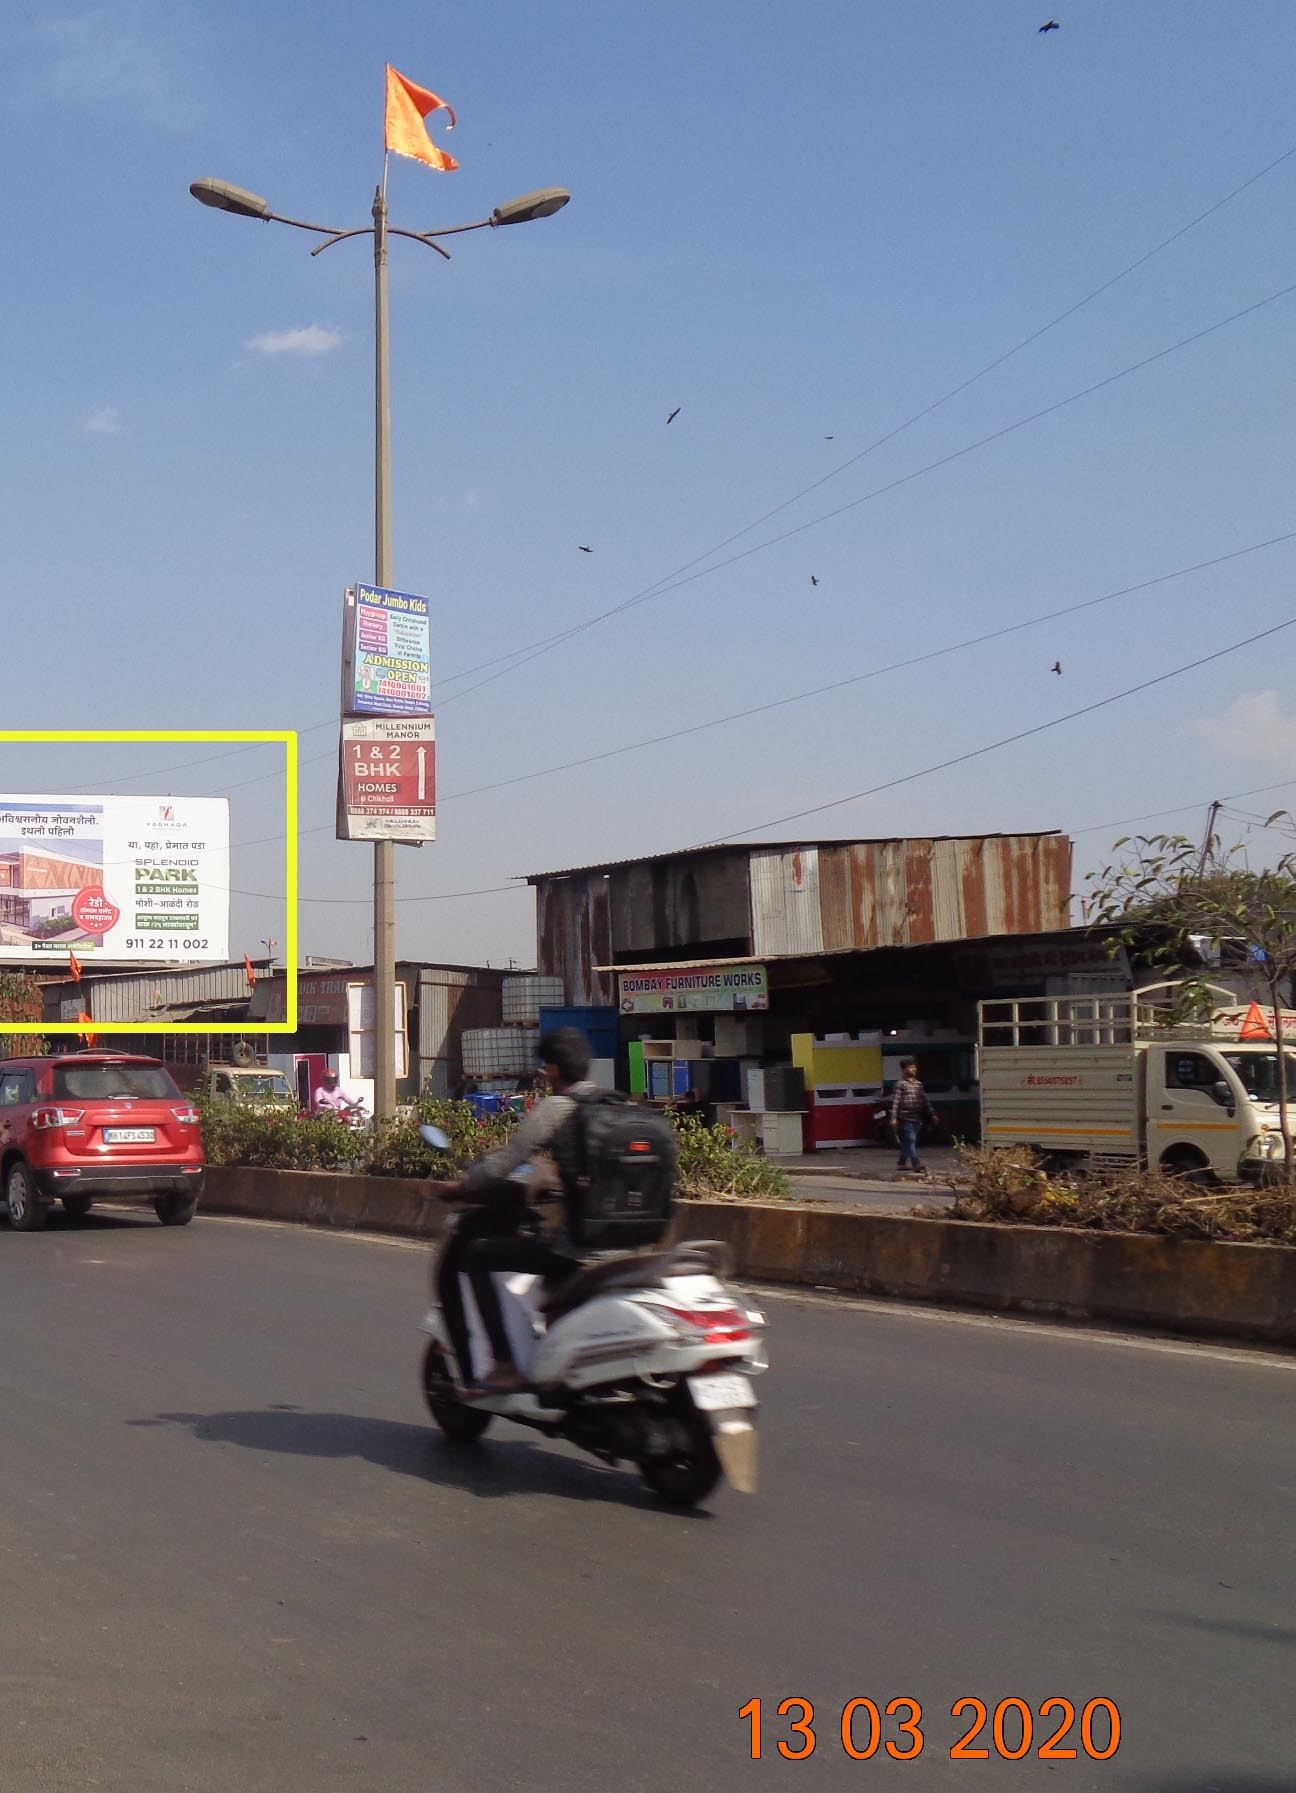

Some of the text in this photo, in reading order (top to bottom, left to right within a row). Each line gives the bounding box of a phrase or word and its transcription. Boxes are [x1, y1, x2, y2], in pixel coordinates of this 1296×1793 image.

[360, 588, 427, 613] Podar Jumbo Kids
[364, 653, 429, 672] ADMISSION
[387, 669, 417, 683] OPEN
[352, 744, 400, 758] 1 & 2
[354, 762, 401, 776] BHK
[358, 784, 397, 792] HOMES
[135, 858, 199, 866] SPLENDID
[135, 868, 198, 882] PARK
[126, 939, 208, 949] 911 22 11 002
[623, 972, 762, 992] BOMBAY FURNITURE WORKS
